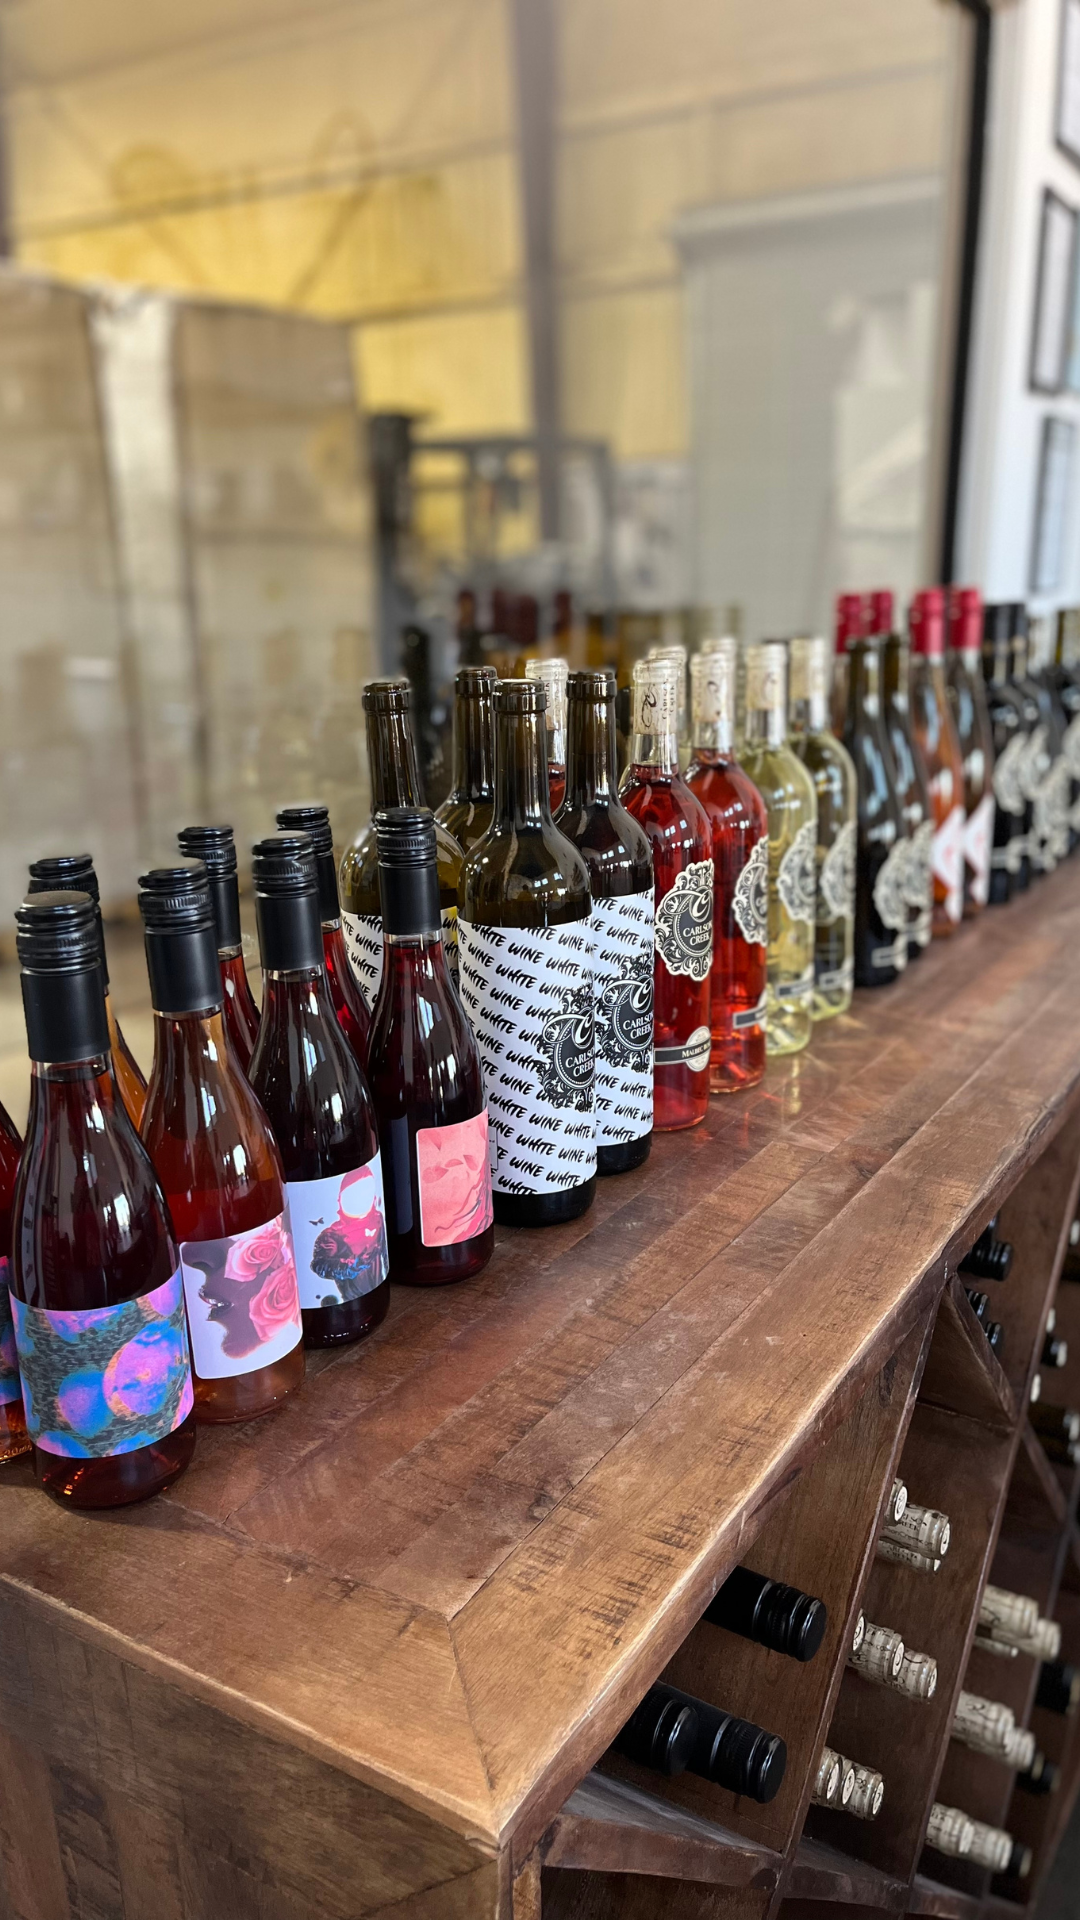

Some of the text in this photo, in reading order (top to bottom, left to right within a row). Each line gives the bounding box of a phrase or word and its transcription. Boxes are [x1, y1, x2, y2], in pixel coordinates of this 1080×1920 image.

[619, 904, 644, 921] WINE
[356, 932, 383, 956] WINE
[558, 933, 584, 951] WINE
[606, 926, 640, 946] WHITE
[472, 922, 507, 947] WHITE
[508, 942, 544, 964] WINE
[546, 957, 580, 977] WHITE
[350, 952, 380, 978] WHITE
[468, 942, 495, 968] WINE
[496, 964, 538, 988] WHITE
[462, 962, 490, 991] WHITE
[490, 988, 524, 1010] WINE
[462, 984, 480, 1009] WINE
[480, 1007, 518, 1034] WHITE
[476, 1029, 505, 1054] WINE
[500, 1073, 535, 1096] WINE
[620, 1082, 648, 1098] WHITE
[488, 1092, 591, 1139] WHITE WINE WHITE
[614, 1104, 640, 1120] WINE
[602, 1125, 636, 1142] WHITE
[516, 1134, 557, 1156] WHITE
[558, 1148, 585, 1162] WINE
[509, 1156, 581, 1187] WINE WHITE
